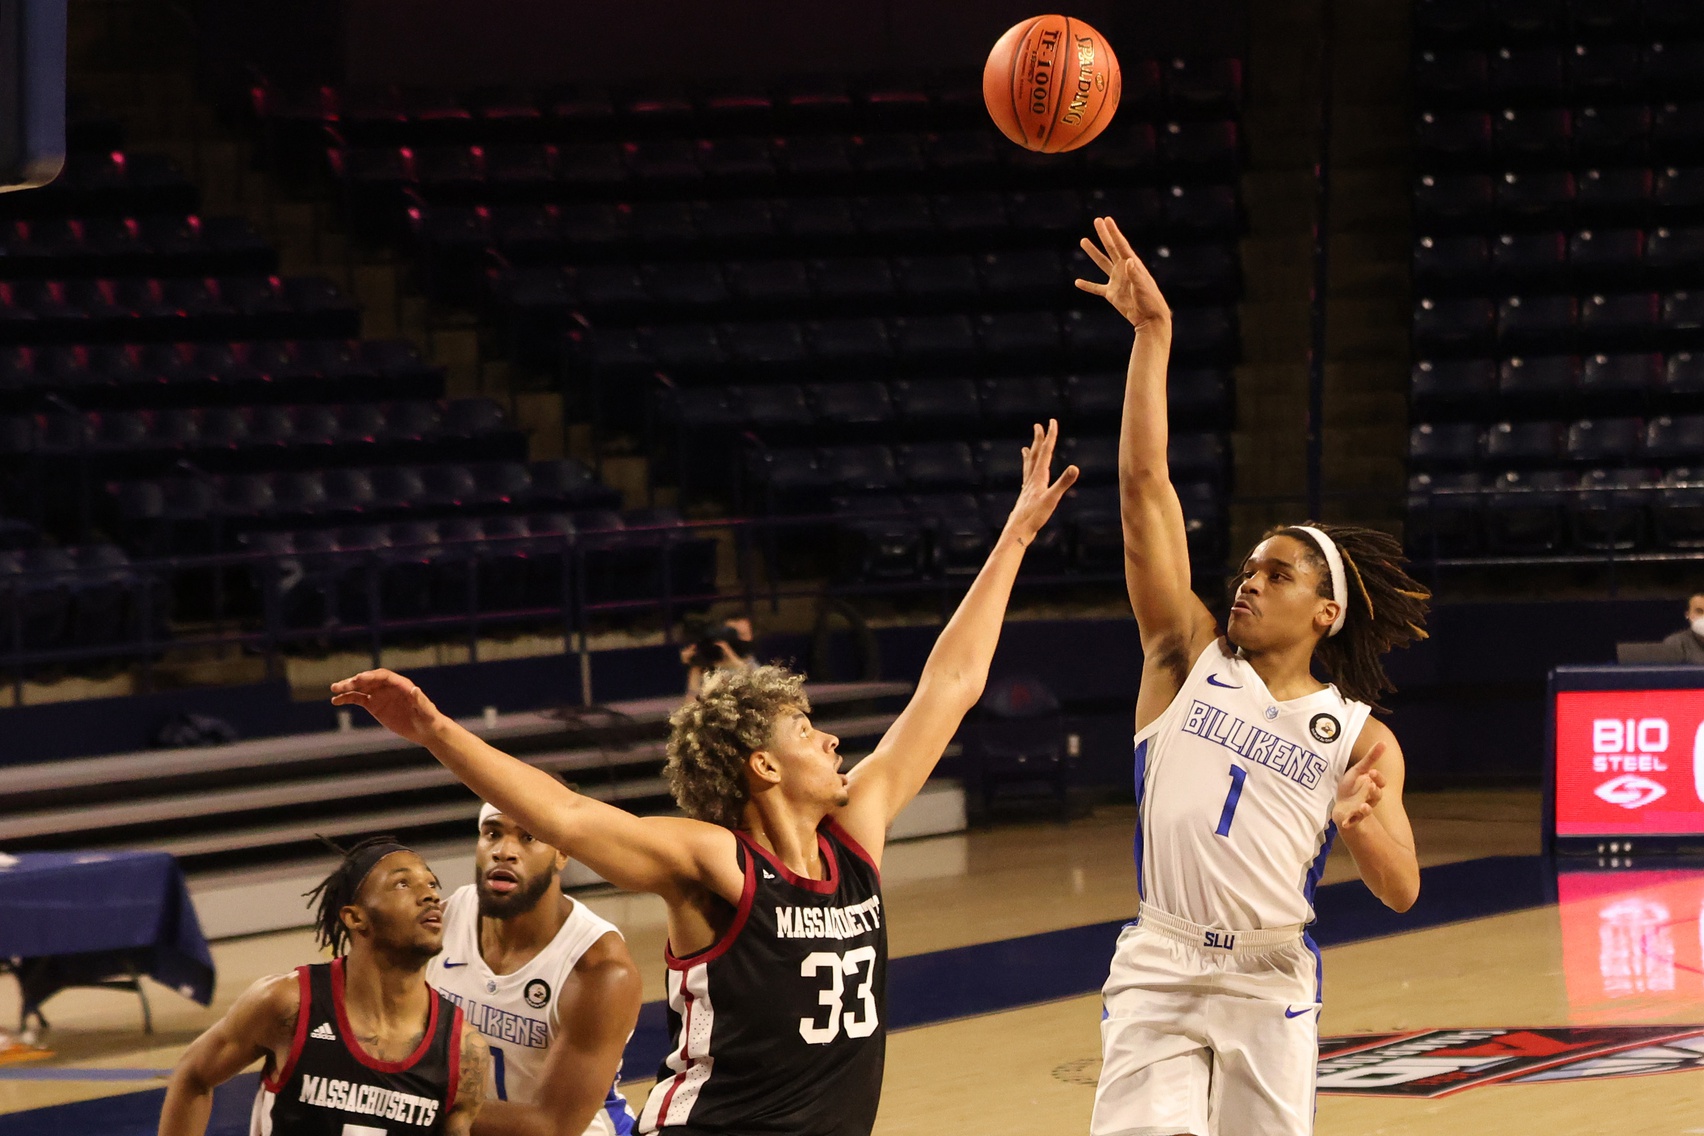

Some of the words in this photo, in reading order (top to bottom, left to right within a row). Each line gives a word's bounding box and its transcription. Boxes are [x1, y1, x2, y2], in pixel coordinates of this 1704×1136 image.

[1032, 30, 1060, 114] TF-1000
[1061, 34, 1095, 126] SPALDING
[1181, 699, 1329, 791] BILLIKENS
[1592, 718, 1670, 753] BIO
[1592, 754, 1668, 772] STEEL
[1215, 763, 1247, 838] 1
[1203, 931, 1235, 950] SLU
[799, 946, 879, 1045] 33
[298, 1074, 439, 1126] MASSACHUSETTS
